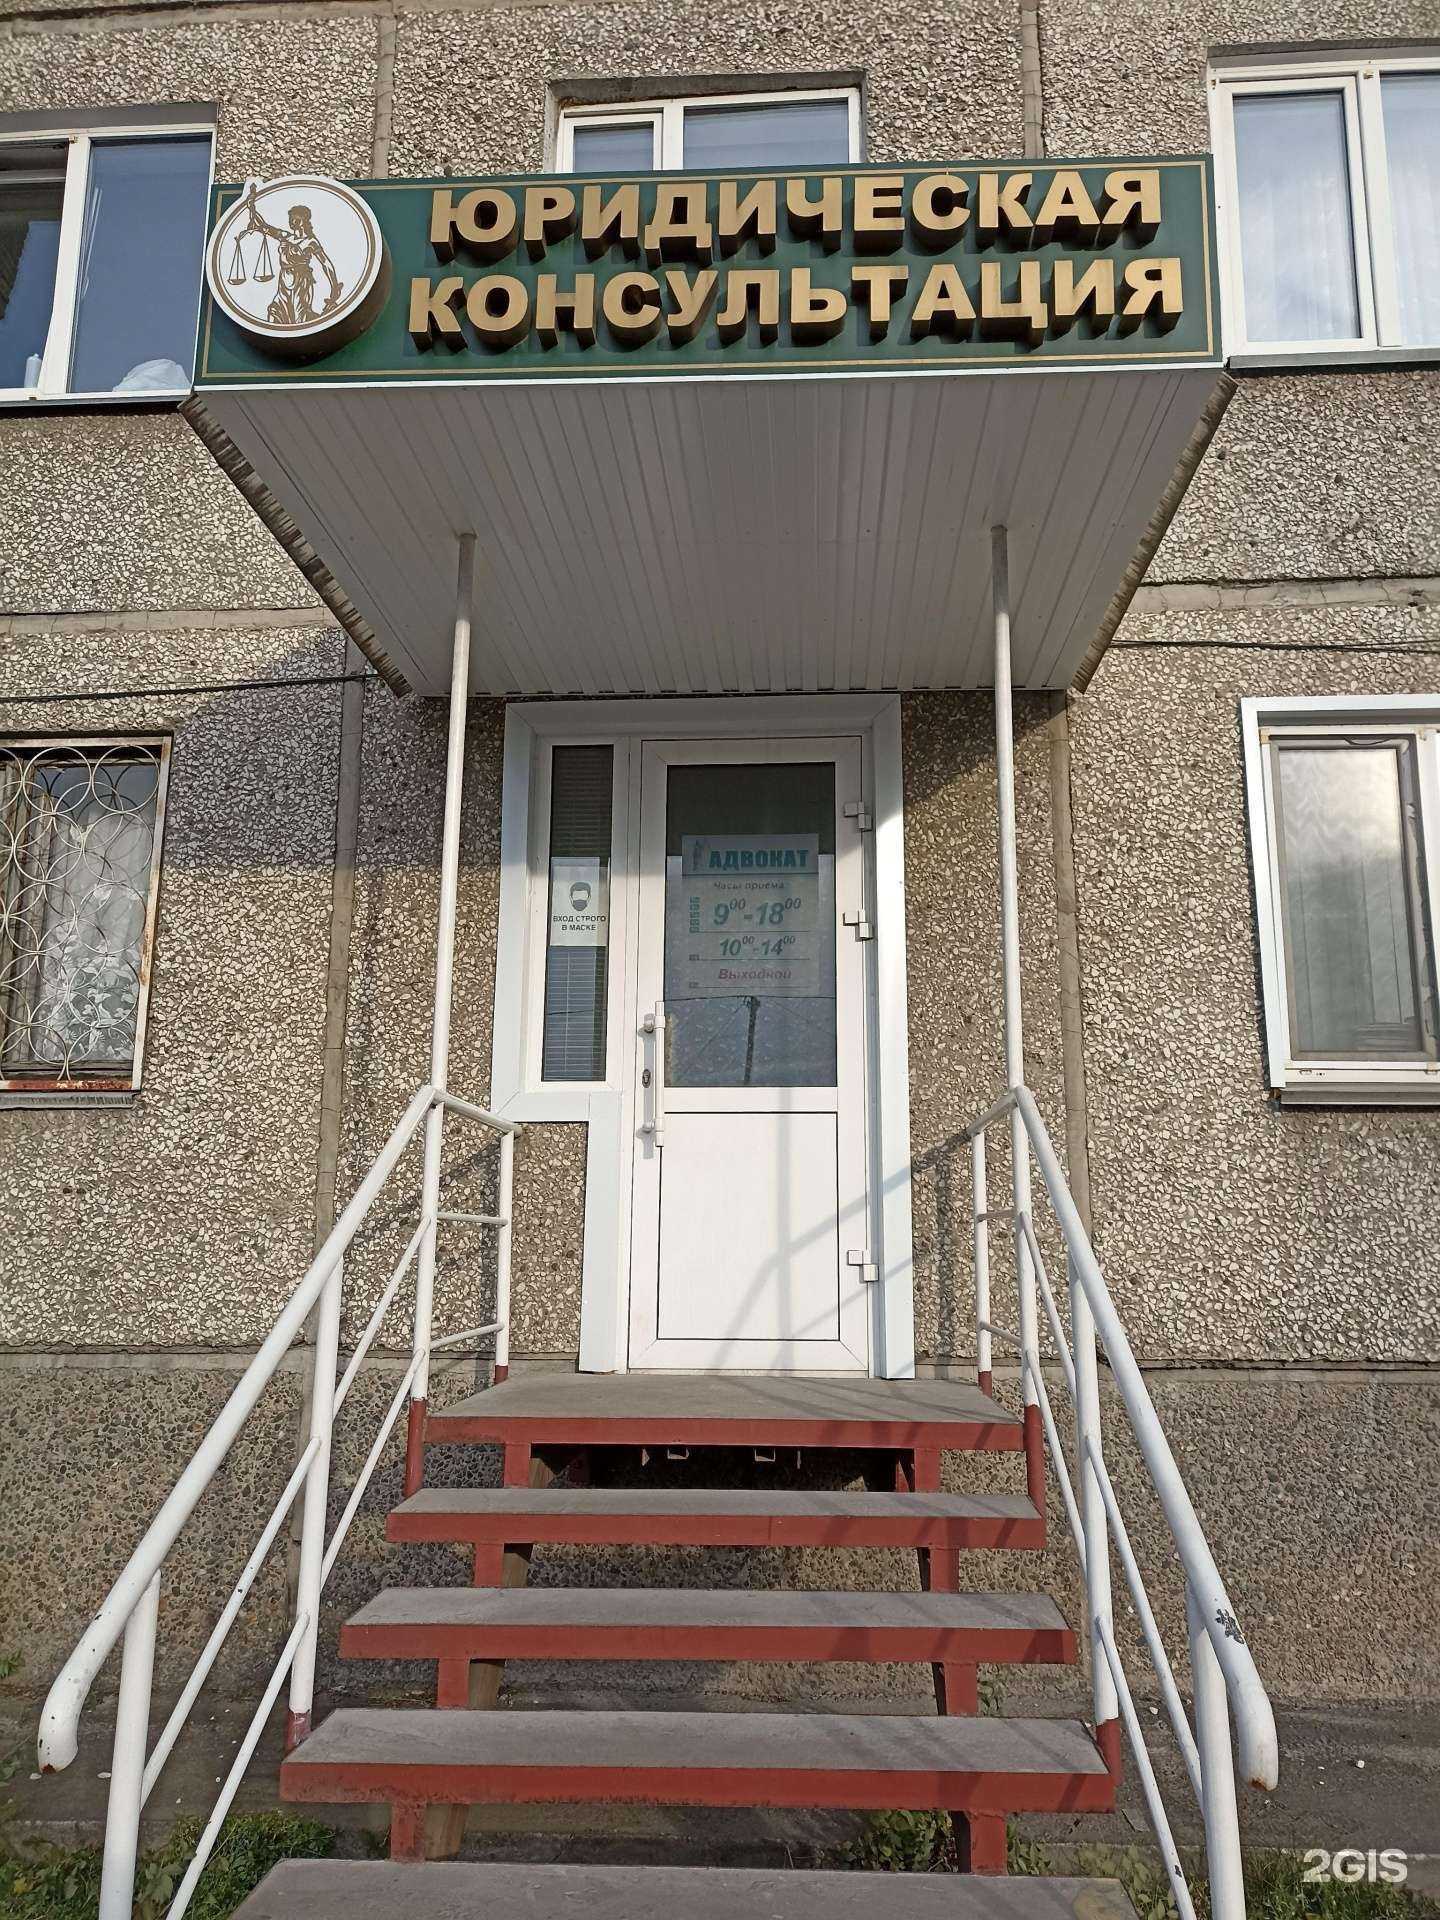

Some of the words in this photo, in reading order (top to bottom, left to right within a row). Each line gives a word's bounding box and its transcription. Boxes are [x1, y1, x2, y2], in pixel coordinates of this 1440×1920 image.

[430, 169, 1162, 256] ЮРИДИЧЕСКАЯ
[408, 257, 1184, 342] КОНСУЛЬТАЦИЯ
[708, 850, 809, 871] АДВОКАТ
[718, 967, 792, 980] Выходной
